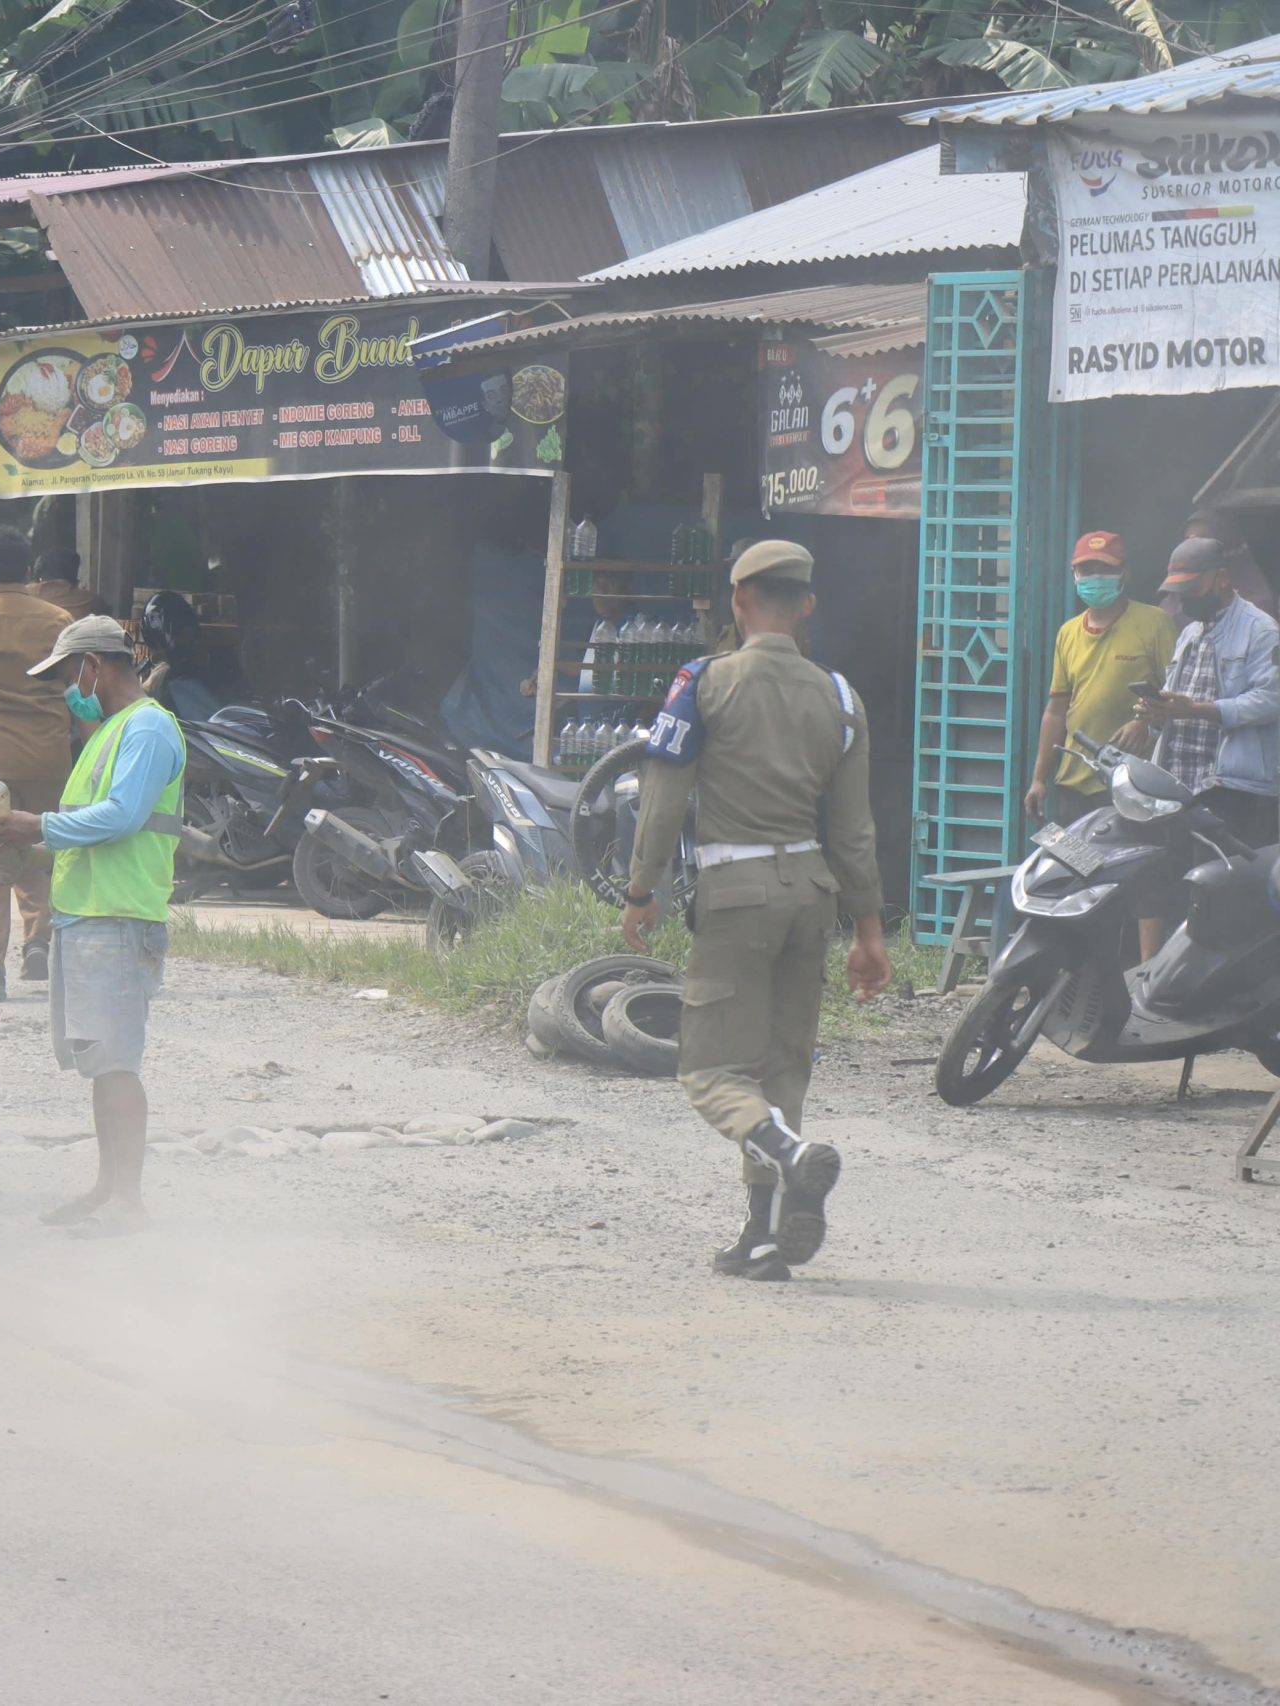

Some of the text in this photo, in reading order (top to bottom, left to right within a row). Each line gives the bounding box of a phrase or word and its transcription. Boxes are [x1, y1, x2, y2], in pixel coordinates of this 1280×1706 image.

[1141, 182, 1211, 200] SUPERIOR
[1070, 212, 1150, 228] GERMAN TECHNOLOGY
[1070, 221, 1256, 256] PELUMAS TANGGUH
[1070, 257, 1280, 294] DI SETIAP PERJALANAN
[200, 314, 428, 394] Dapur Bund
[1068, 337, 1267, 374] RASYID MOTOR
[150, 389, 200, 407] Menyediakan
[164, 409, 264, 431] NASI AYAM PENYET
[279, 402, 374, 423] INDOMIE GORENG
[771, 406, 809, 433] GALAN
[164, 435, 238, 455] NASI GORENG
[280, 427, 381, 448] MIE SOP KAMPUNG
[399, 425, 422, 442] DLL
[650, 711, 691, 755] TI
[377, 749, 445, 788] VARIO
[486, 773, 522, 819] VARIO
